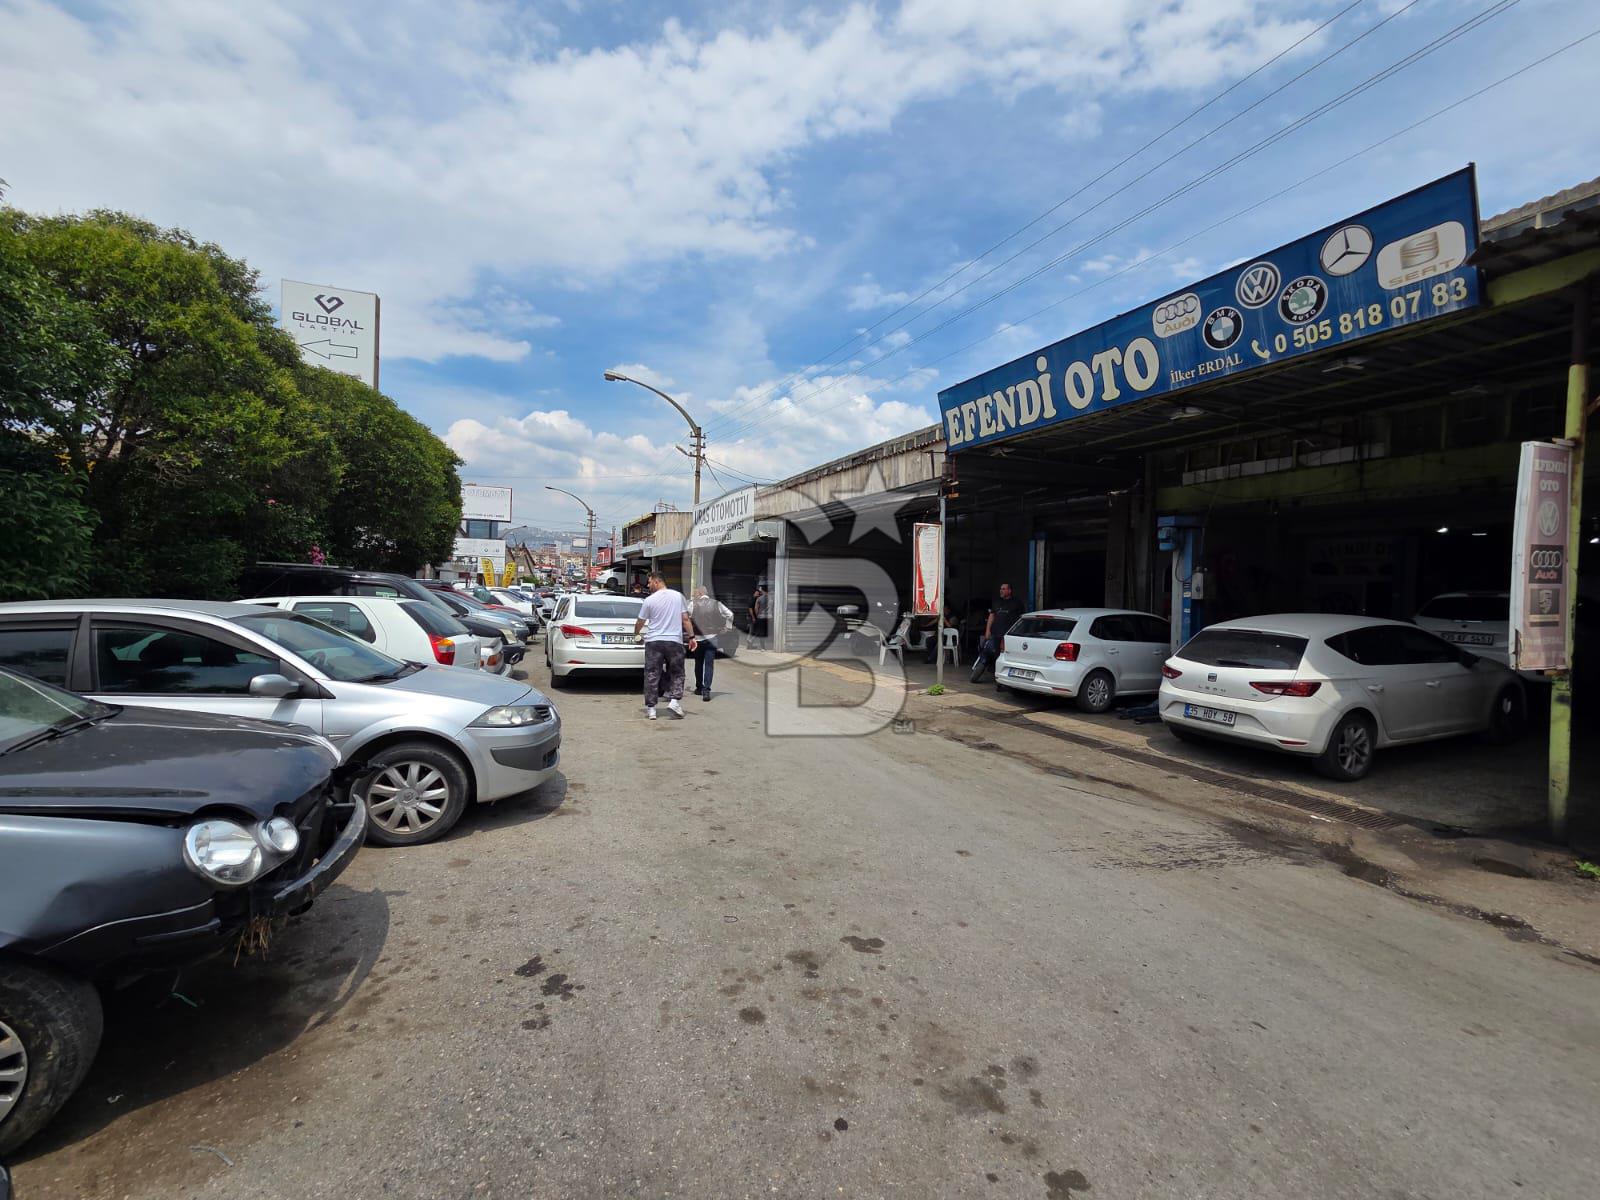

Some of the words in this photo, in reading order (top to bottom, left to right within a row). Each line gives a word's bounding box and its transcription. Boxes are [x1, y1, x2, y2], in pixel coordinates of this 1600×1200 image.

[1389, 258, 1456, 287] SEAT
[1282, 279, 1320, 301] SKODA
[292, 311, 364, 330] GLOBAL
[1207, 309, 1236, 325] BMW
[1274, 333, 1288, 353] 0
[1293, 319, 1332, 348] 505
[1339, 303, 1383, 335] 818
[1390, 289, 1422, 319] 07
[1431, 277, 1468, 307] 83
[1292, 309, 1317, 321] AUTO
[1163, 316, 1195, 335] Audi
[1064, 337, 1160, 410] OTO
[1198, 353, 1243, 375] ERDAL
[1540, 479, 1560, 492] OTO
[1535, 570, 1558, 580] Audi
